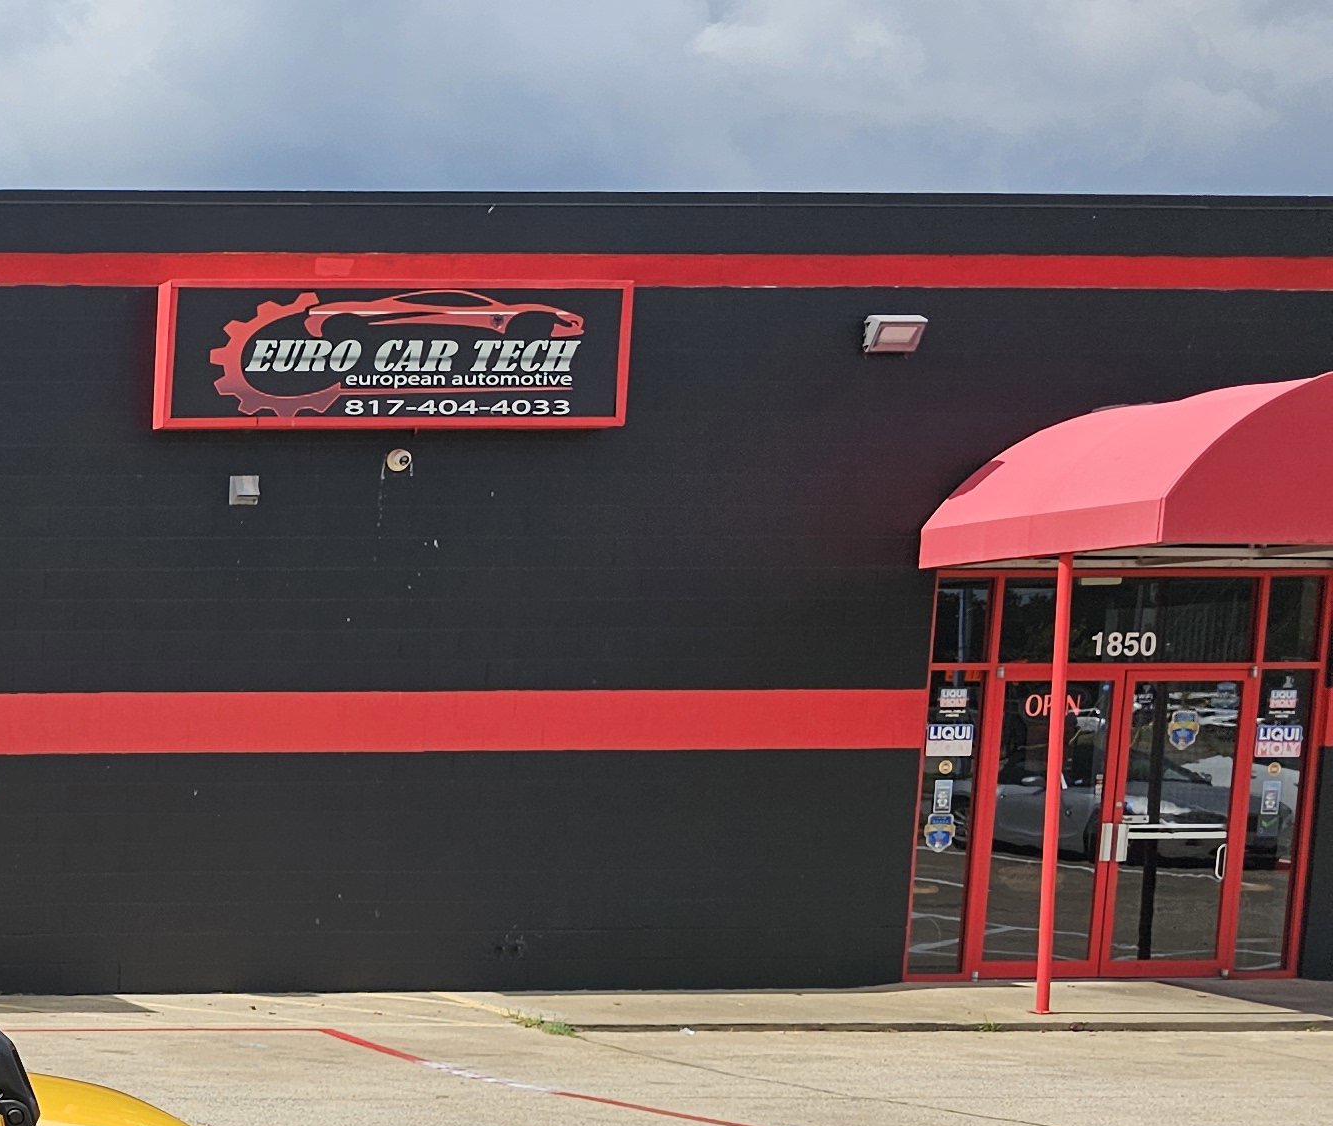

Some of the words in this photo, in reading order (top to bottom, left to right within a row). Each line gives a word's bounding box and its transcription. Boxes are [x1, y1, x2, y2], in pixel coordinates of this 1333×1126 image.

[245, 340, 361, 372] EURO
[373, 340, 463, 373] CAR
[472, 340, 582, 373] TECH
[344, 372, 447, 389] european
[451, 371, 574, 387] automotive
[343, 398, 572, 416] 817-404-4033
[1091, 631, 1157, 657] 1850
[1025, 694, 1081, 717] OPN
[929, 725, 972, 740] LIQUI
[1258, 726, 1301, 741] LIQUI
